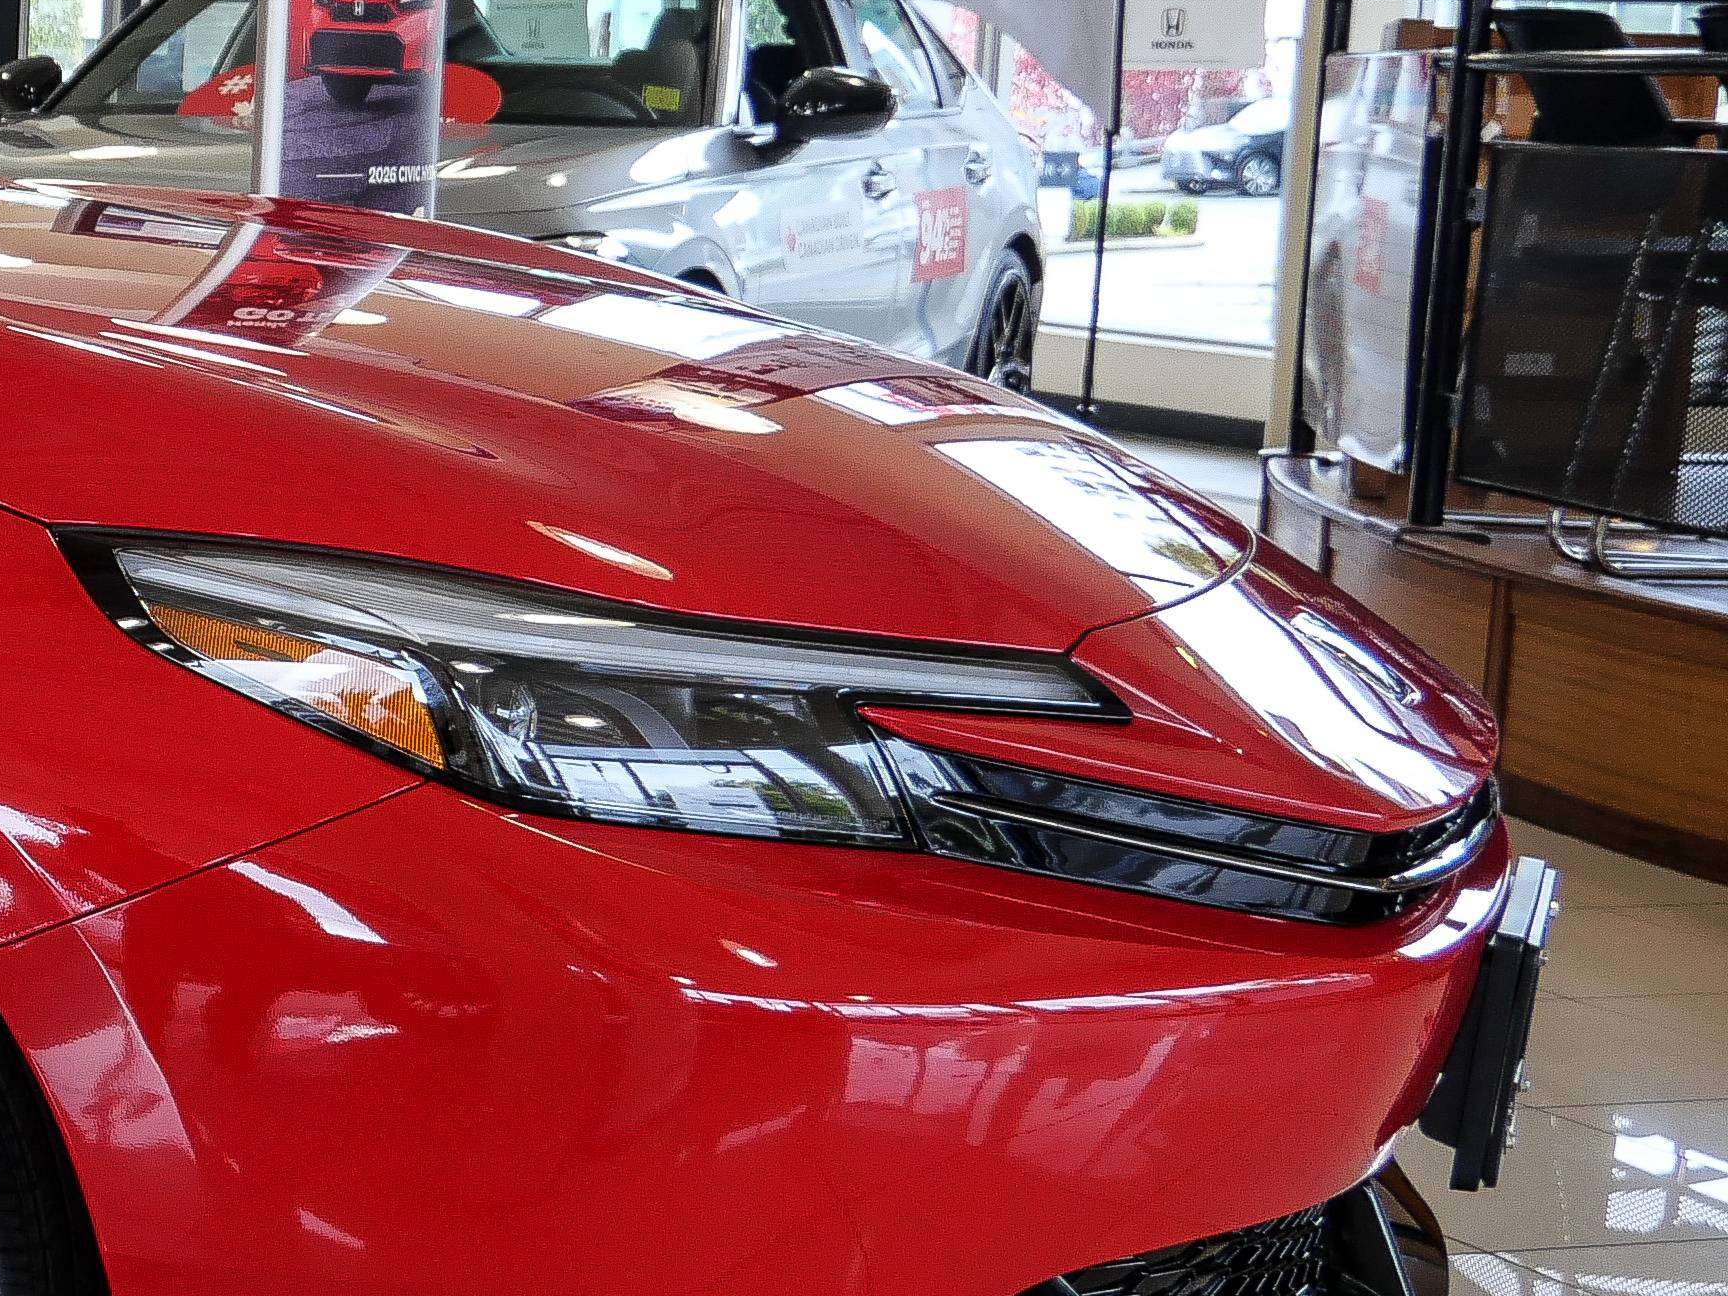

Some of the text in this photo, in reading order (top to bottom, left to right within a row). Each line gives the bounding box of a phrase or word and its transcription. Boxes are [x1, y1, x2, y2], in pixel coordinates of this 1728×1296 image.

[1151, 40, 1195, 50] HONDA
[368, 165, 398, 185] 2026
[398, 164, 421, 184] CIVIC
